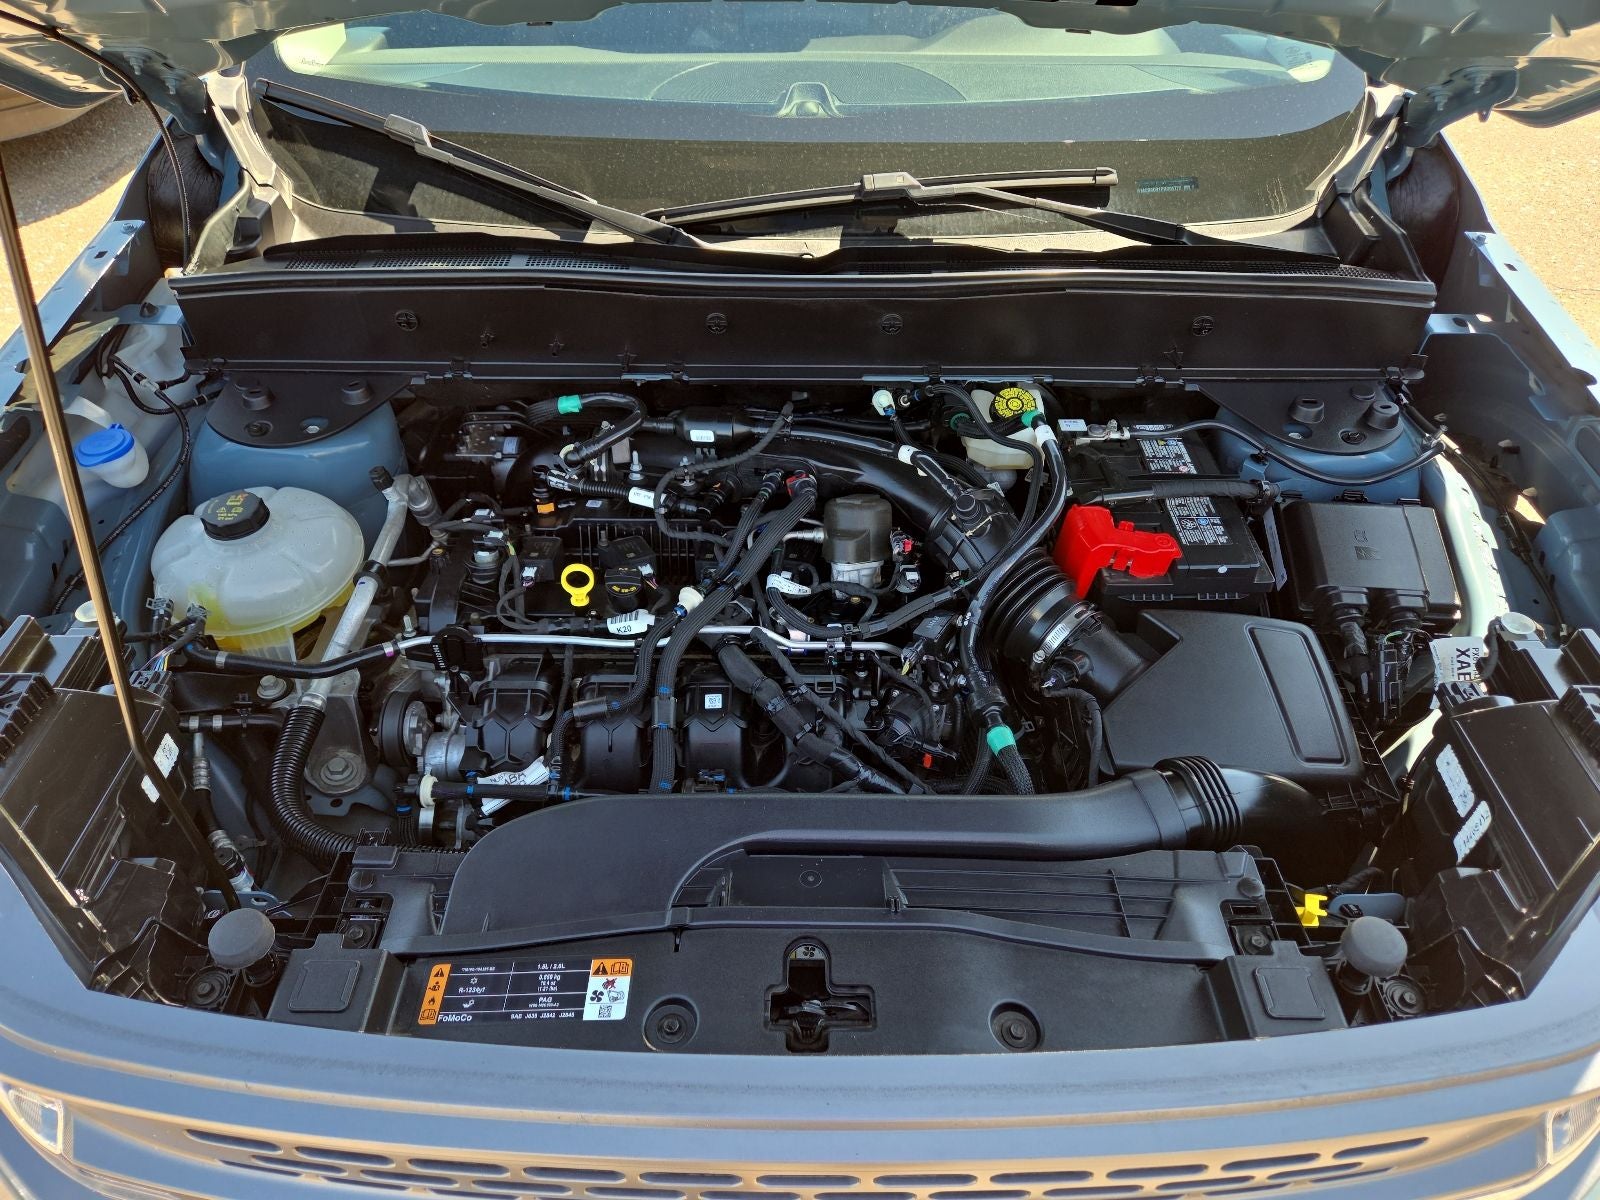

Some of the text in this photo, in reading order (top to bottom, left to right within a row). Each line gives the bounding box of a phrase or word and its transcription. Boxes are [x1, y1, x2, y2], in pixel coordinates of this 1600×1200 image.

[616, 625, 632, 633] K20
[458, 986, 486, 994] R-1234yf
[437, 1013, 473, 1022] FoMoCo
